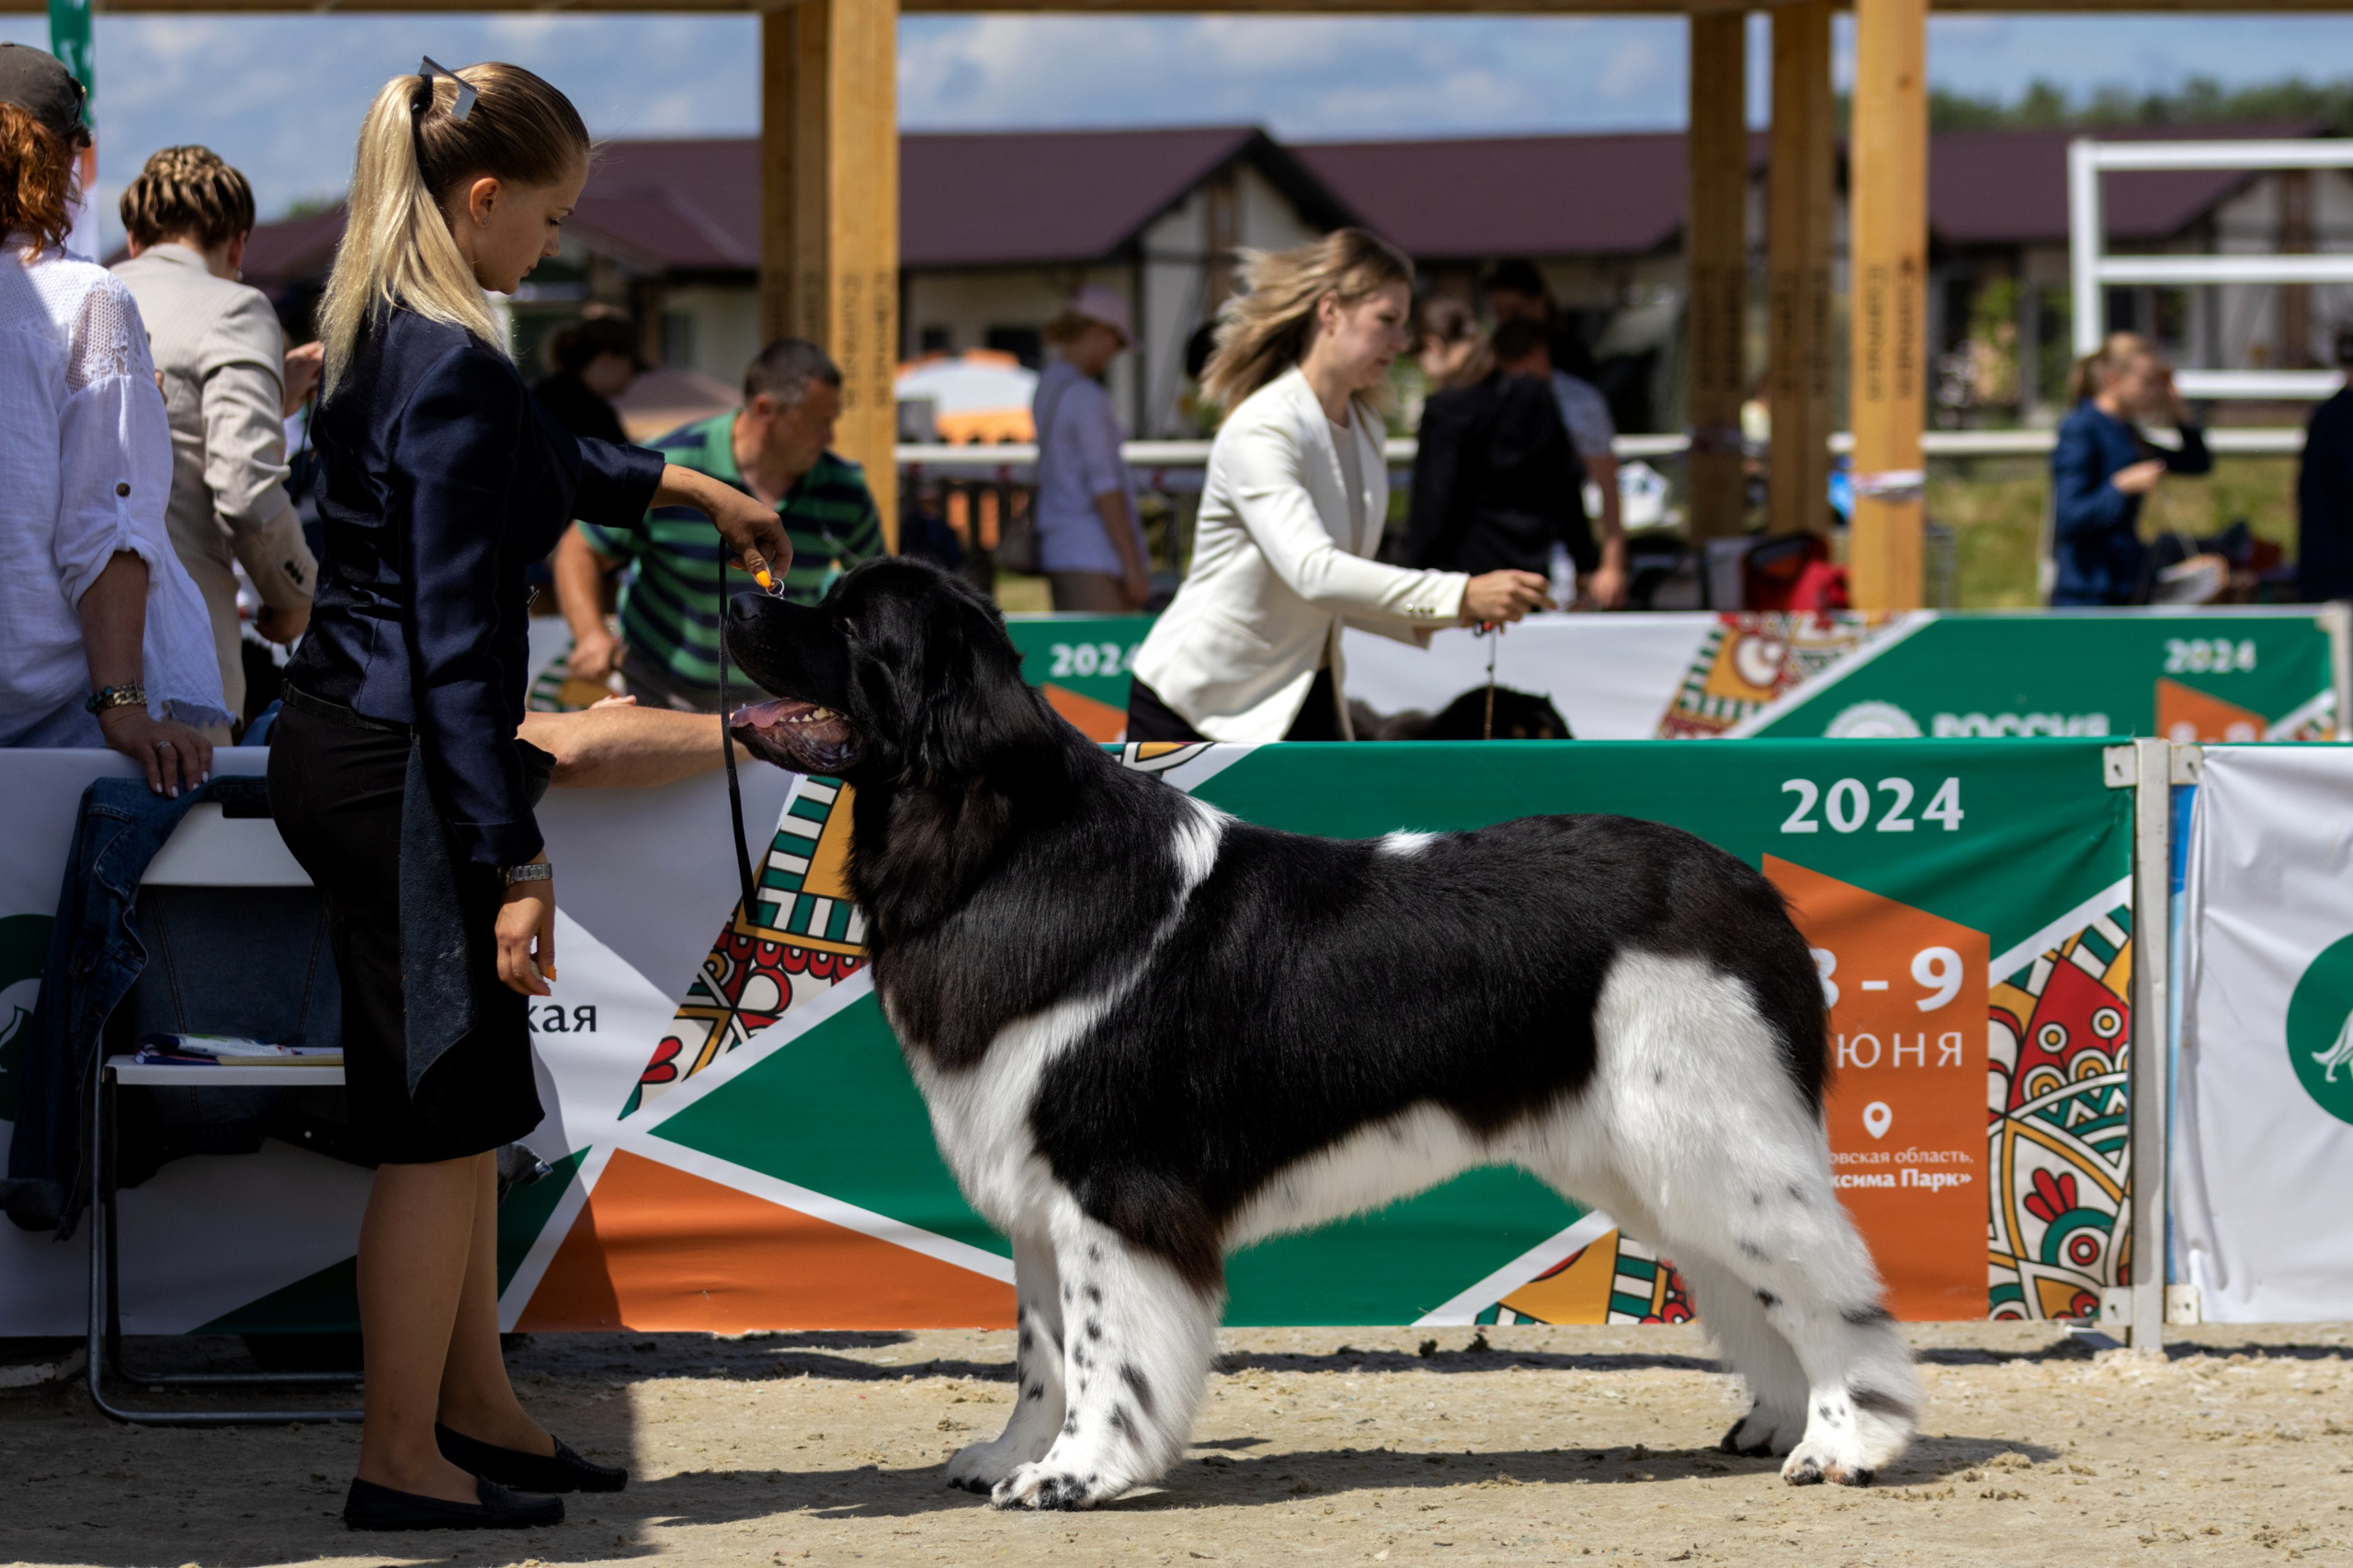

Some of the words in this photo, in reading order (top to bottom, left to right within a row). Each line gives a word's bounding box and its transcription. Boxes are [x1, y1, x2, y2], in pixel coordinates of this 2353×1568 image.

[2165, 638, 2256, 673] 2024
[1780, 777, 1964, 833] 2024
[1910, 946, 1963, 1012] 9
[529, 1005, 597, 1033] кая
[1837, 1031, 1962, 1068] ЮНЯ
[1829, 1151, 1890, 1165] овская
[1894, 1146, 1974, 1165] область,
[1830, 1172, 1896, 1188] ксима
[1901, 1168, 1973, 1193] Парк»
